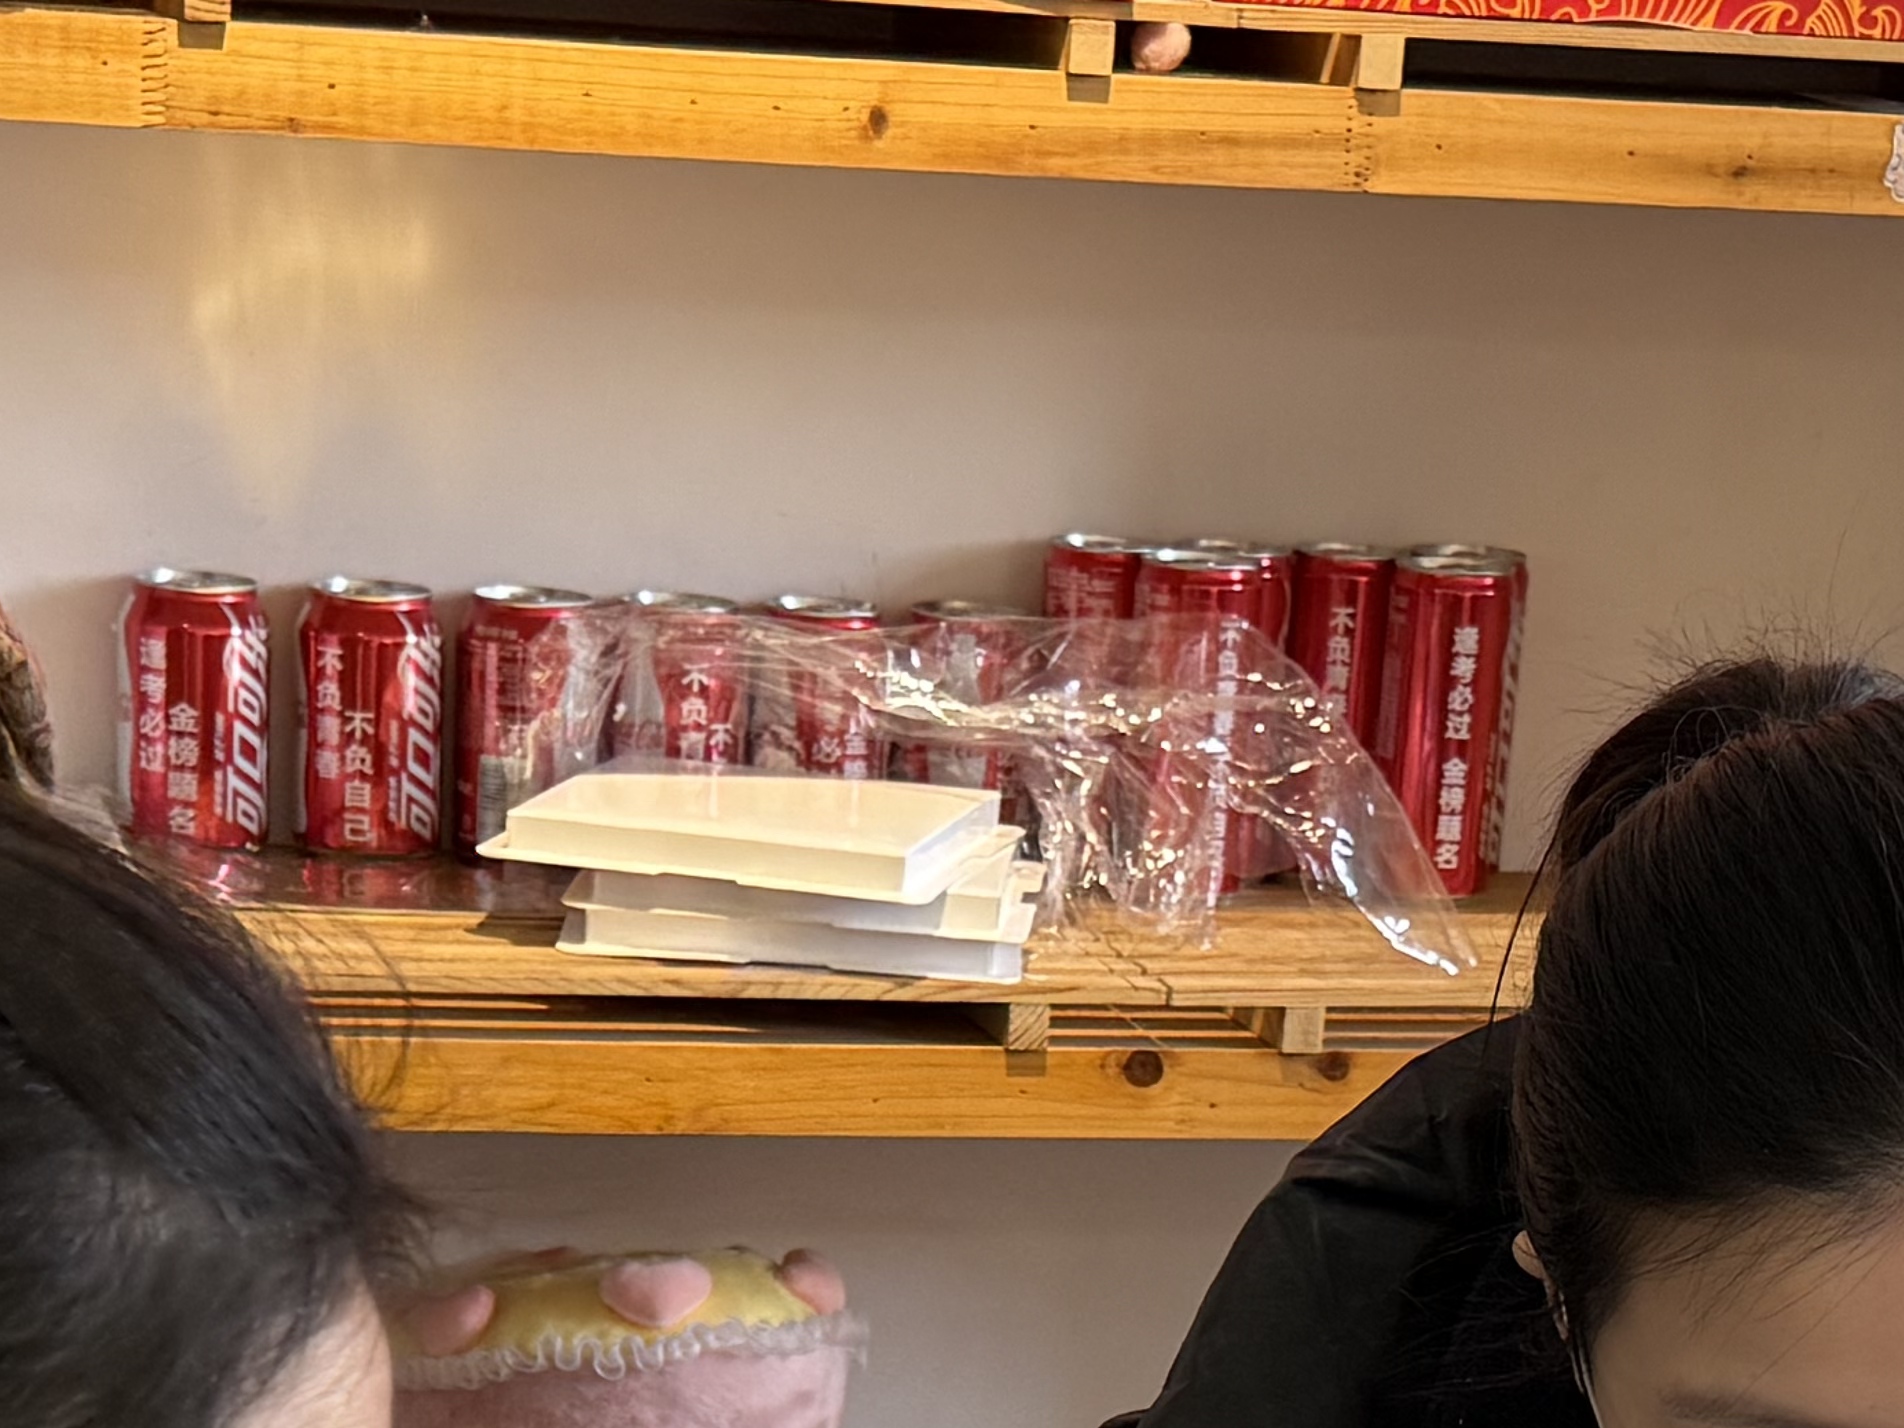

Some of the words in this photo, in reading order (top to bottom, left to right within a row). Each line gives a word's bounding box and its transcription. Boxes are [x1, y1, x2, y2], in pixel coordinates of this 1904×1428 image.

[140, 637, 166, 772] 逢考必过
[316, 647, 343, 779] 不负青春
[1445, 626, 1479, 741] 逢考必过
[167, 702, 199, 836] 金榜题名
[343, 711, 374, 843] 不负自己
[1434, 757, 1468, 871] 金榜题名
